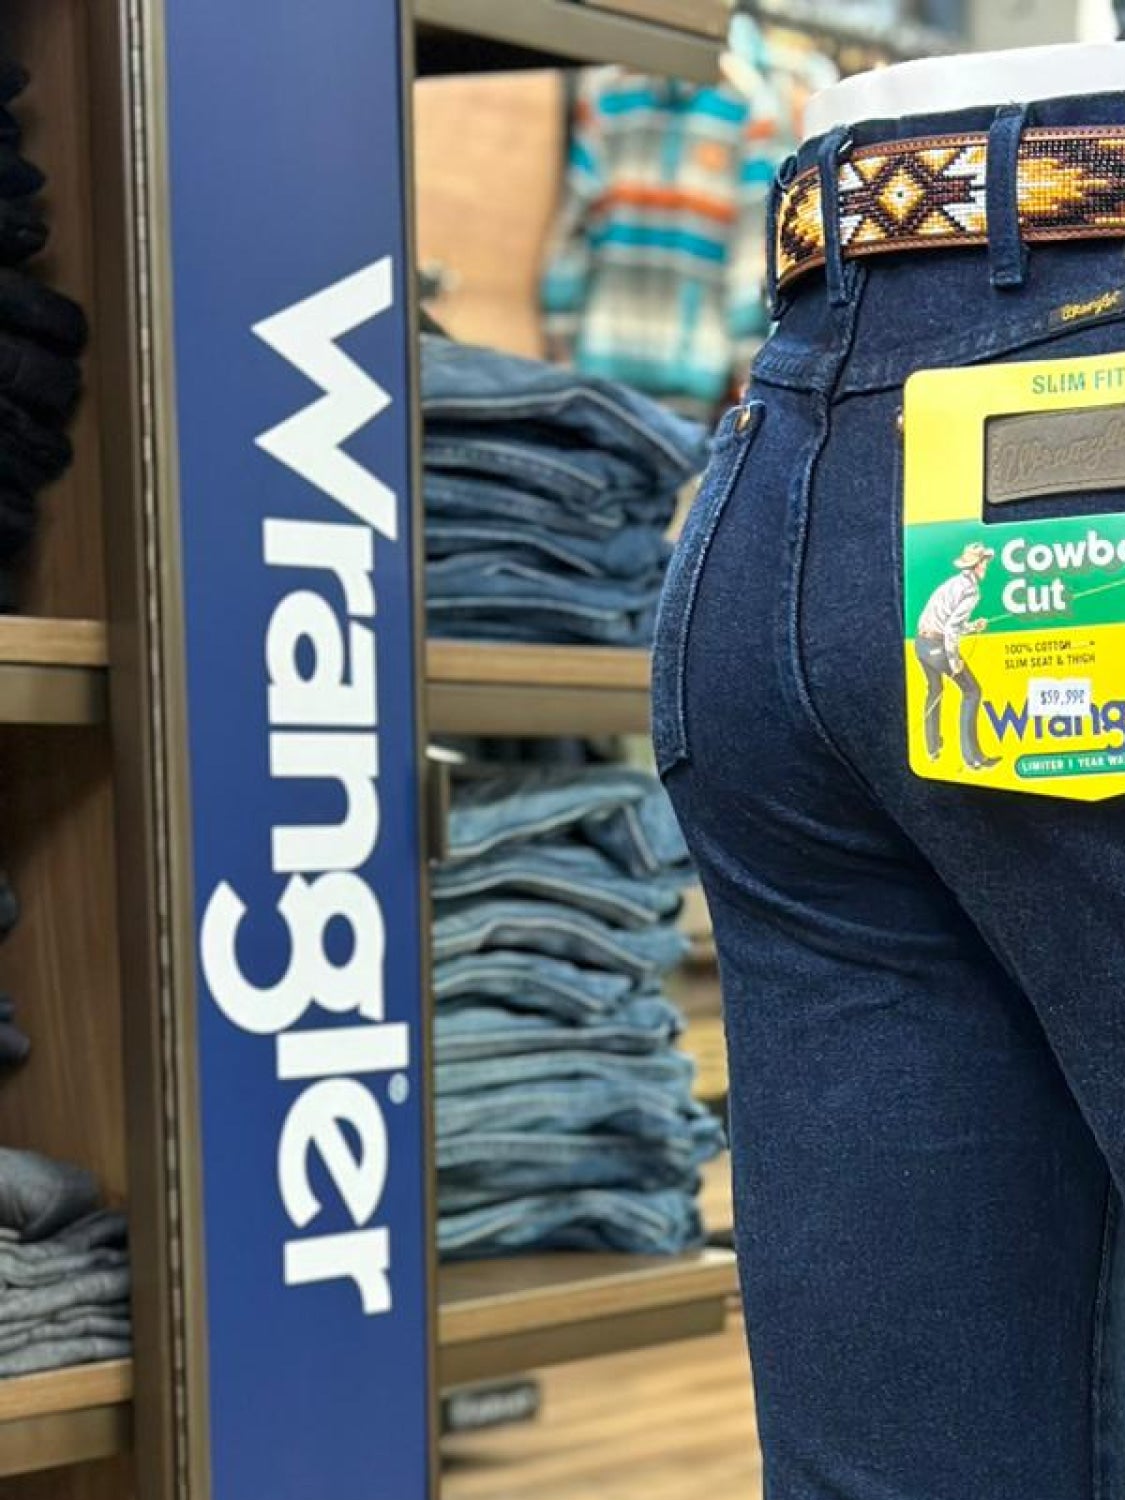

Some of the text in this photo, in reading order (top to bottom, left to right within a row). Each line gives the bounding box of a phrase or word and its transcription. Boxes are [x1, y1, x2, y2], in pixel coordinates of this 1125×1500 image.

[1032, 366, 1125, 394] SLIM FIT
[1002, 579, 1066, 613] Cut
[1005, 659, 1028, 670] SLIM
[1031, 655, 1053, 667] SEAT
[1021, 760, 1064, 773] LIMITED
[1078, 757, 1104, 768] YEAR
[201, 254, 410, 1316] Wrangler
